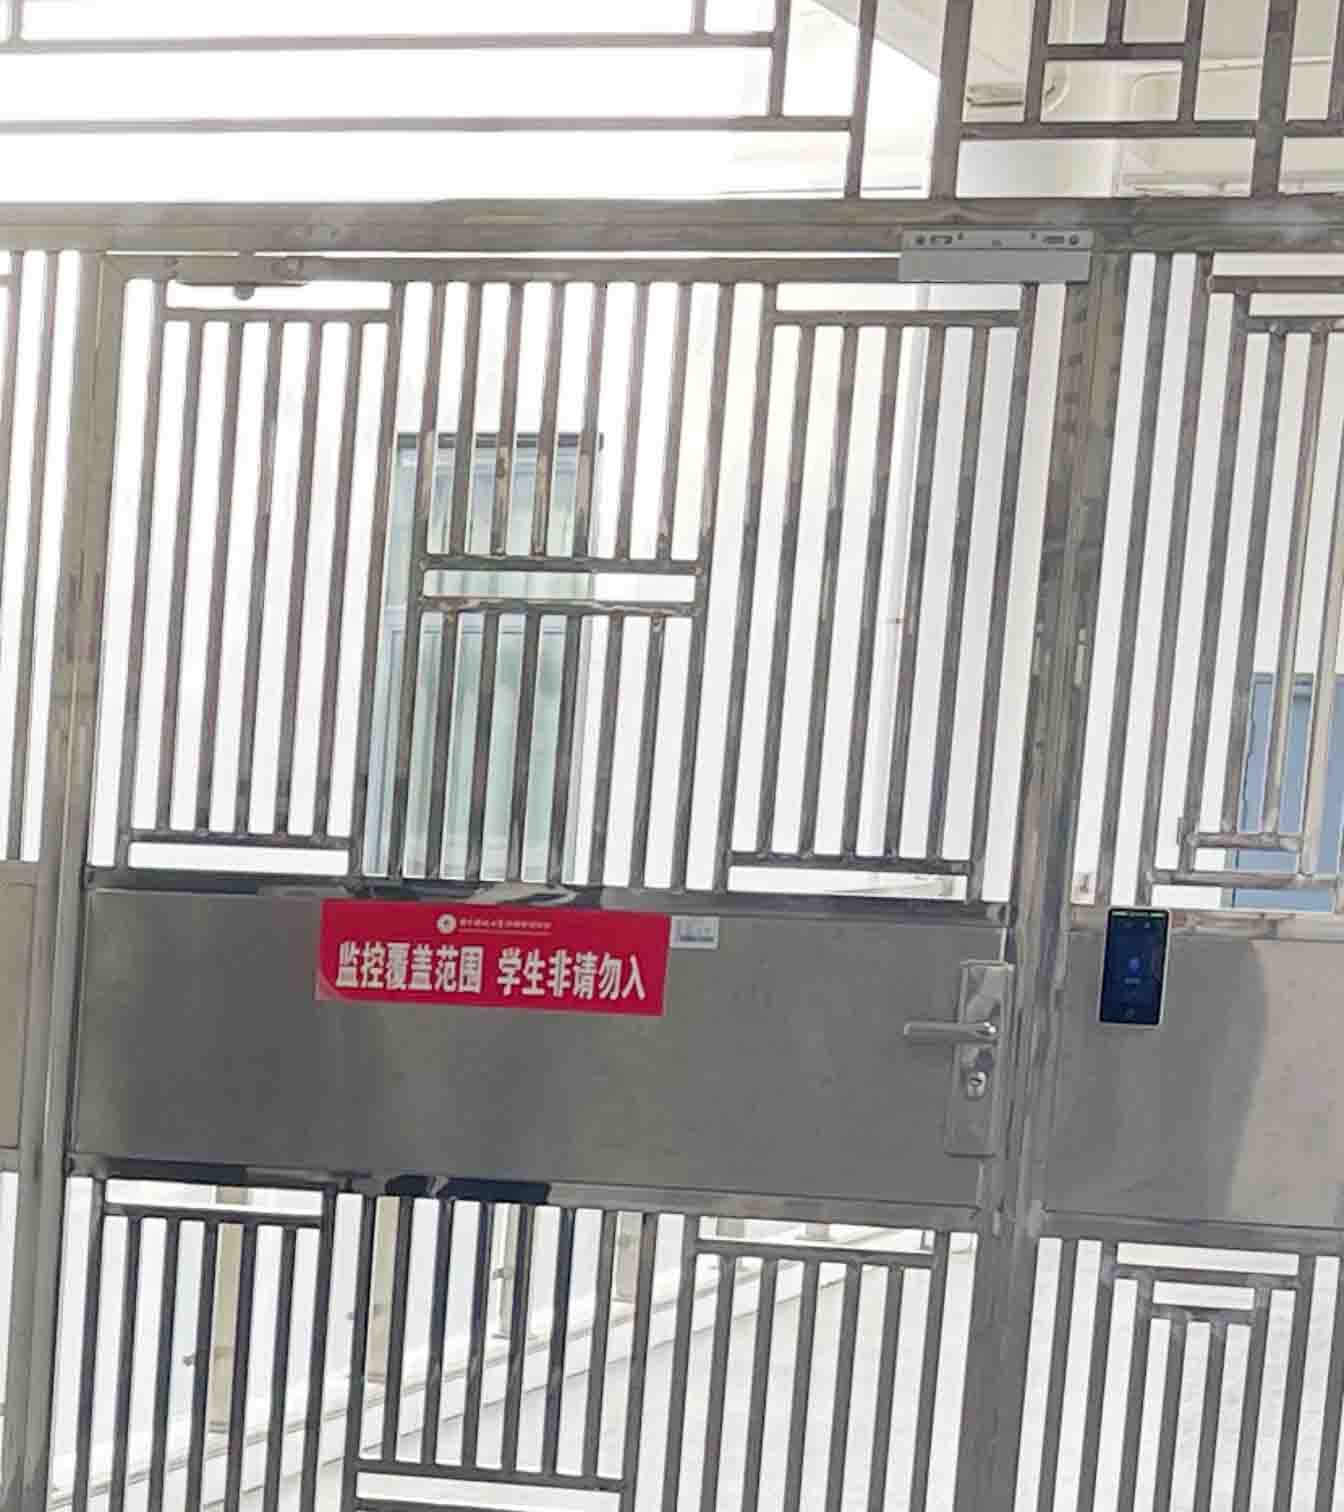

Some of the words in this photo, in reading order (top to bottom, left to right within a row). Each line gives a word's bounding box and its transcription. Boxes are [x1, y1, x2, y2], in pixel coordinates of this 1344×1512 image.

[335, 940, 484, 994] 监控覆盖范围
[497, 947, 647, 1001] 学生非请勿入
